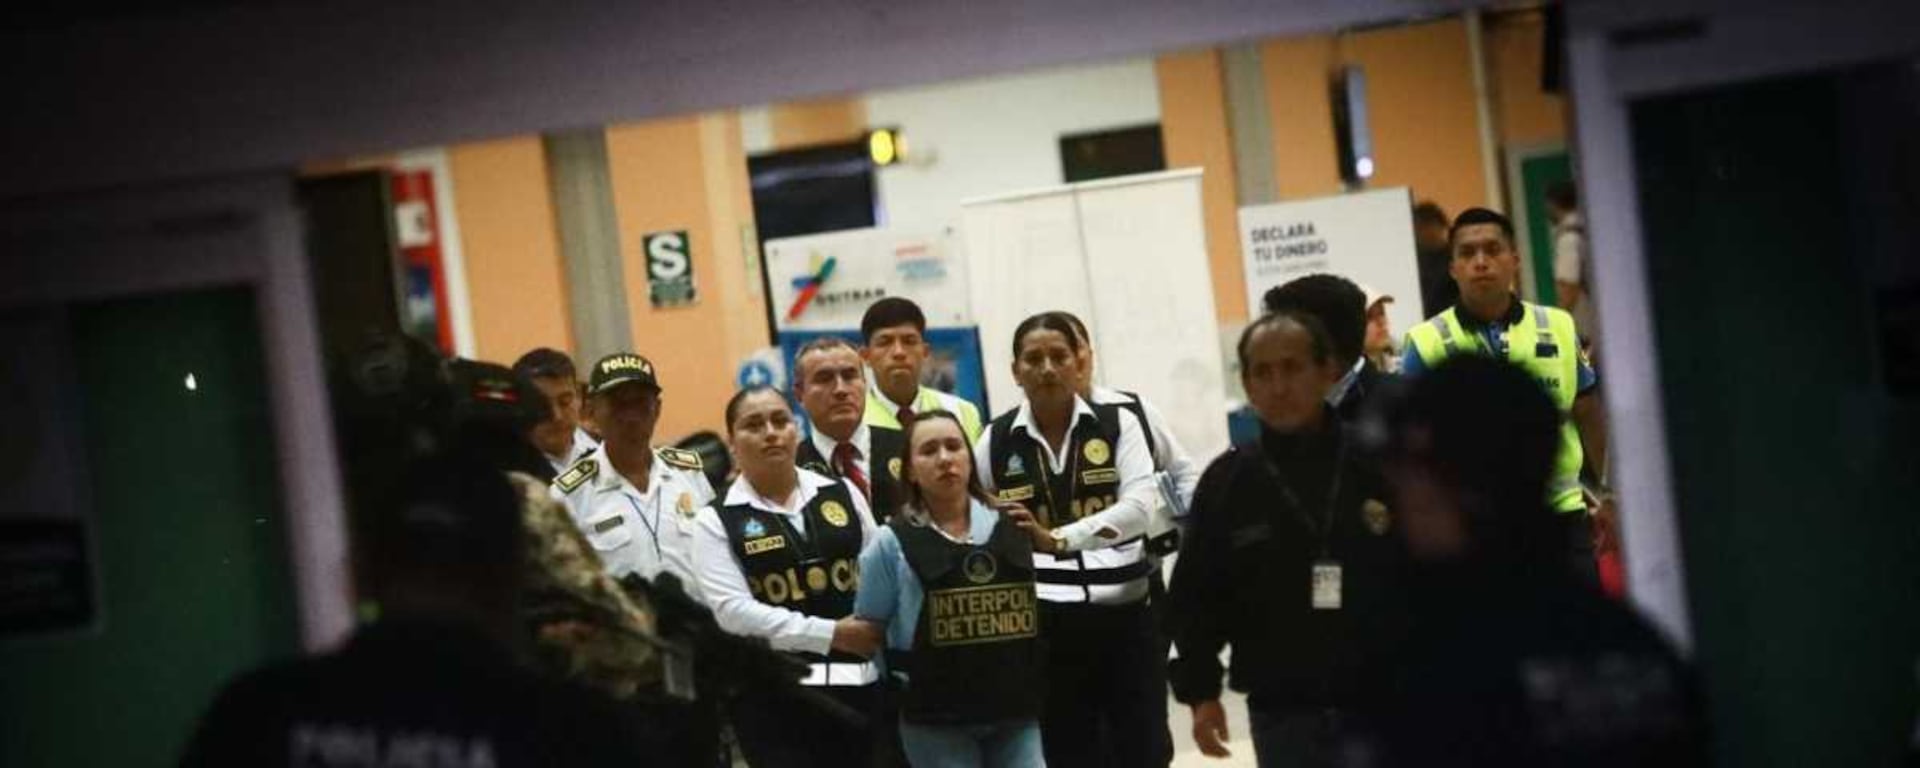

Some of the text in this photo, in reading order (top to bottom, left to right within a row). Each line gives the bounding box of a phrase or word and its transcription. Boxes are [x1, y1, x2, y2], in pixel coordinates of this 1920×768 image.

[1251, 222, 1316, 243] DECLARA
[648, 232, 688, 280] S
[1254, 240, 1328, 261] TU DINERO
[602, 354, 652, 375] POLICIA
[935, 588, 1033, 617] INTERPOL
[935, 609, 1034, 641] DETENIDO
